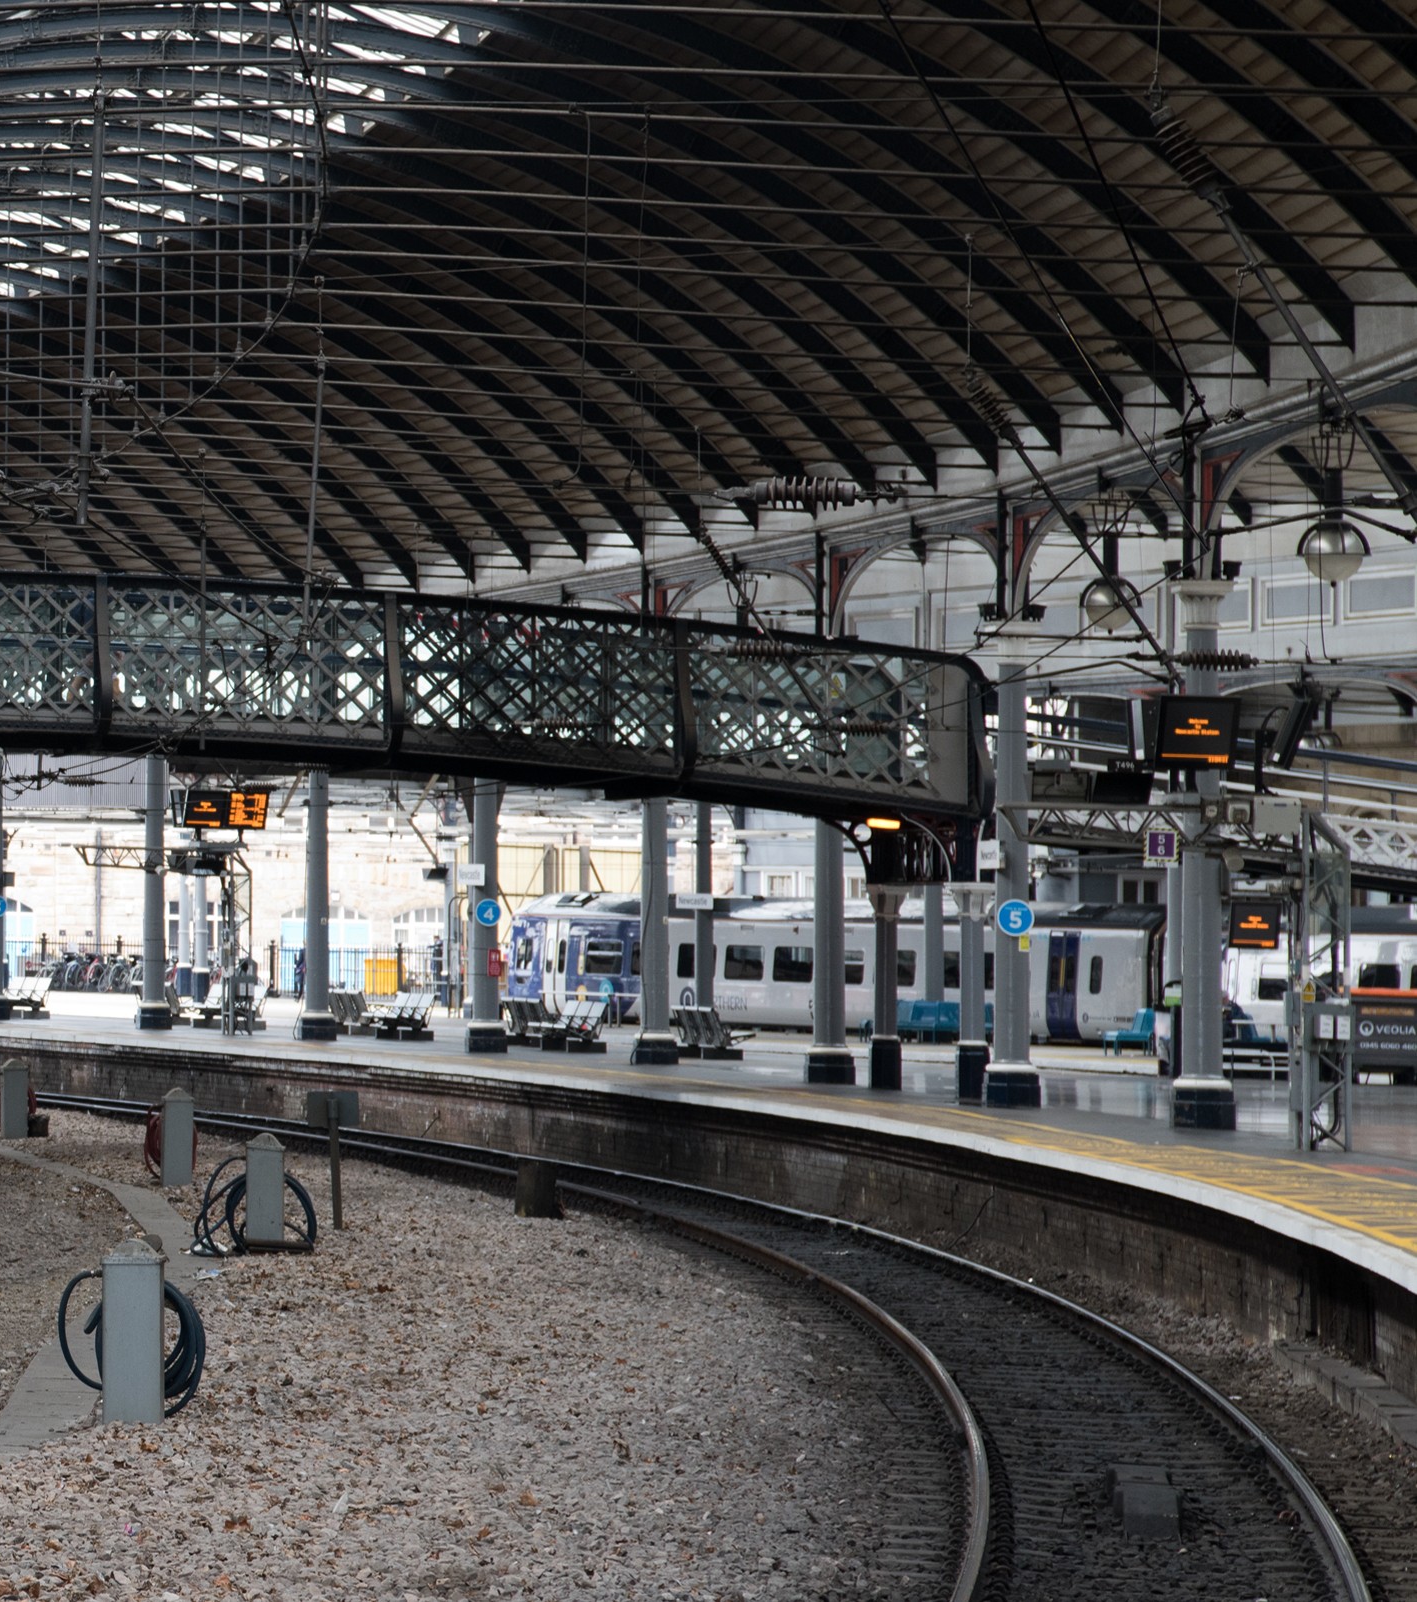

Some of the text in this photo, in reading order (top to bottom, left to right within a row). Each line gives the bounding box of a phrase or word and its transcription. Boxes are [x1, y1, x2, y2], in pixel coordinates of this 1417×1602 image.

[1115, 761, 1135, 769] T496
[1158, 834, 1165, 845] 5
[1157, 845, 1165, 856] 6
[483, 907, 494, 921] 4
[1009, 911, 1023, 929] 5
[1376, 1024, 1416, 1036] VEOLIA
